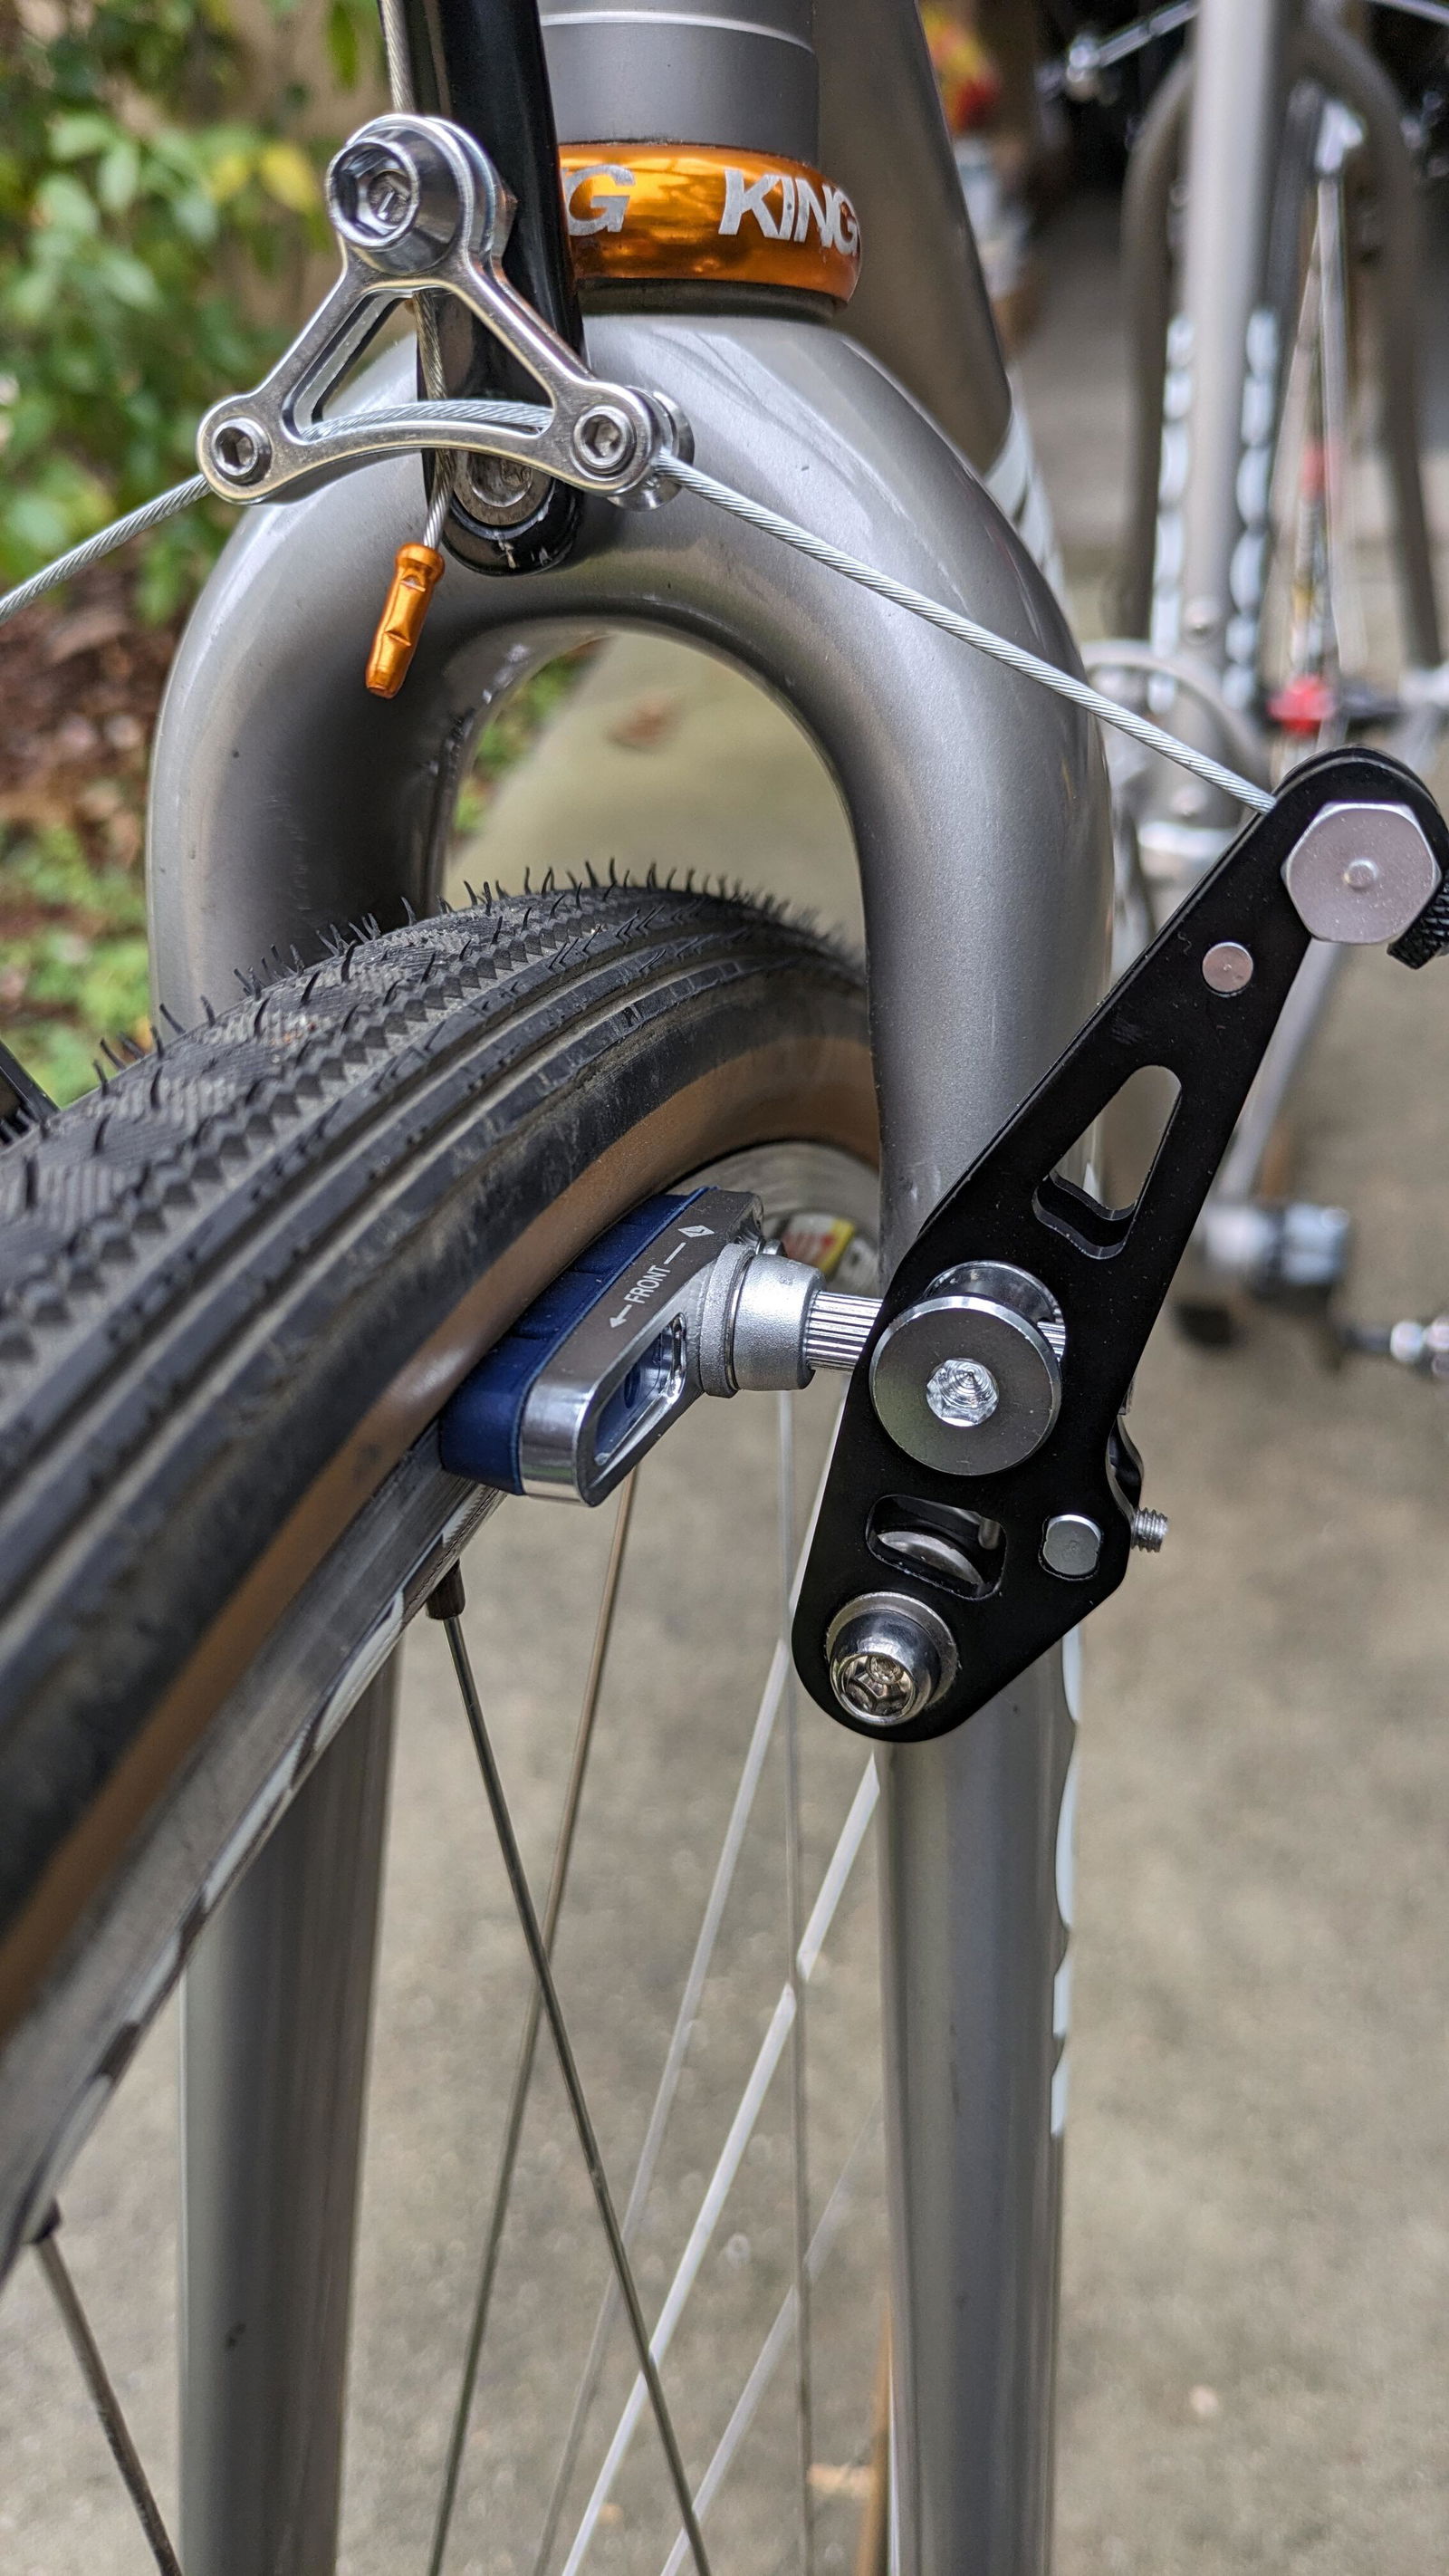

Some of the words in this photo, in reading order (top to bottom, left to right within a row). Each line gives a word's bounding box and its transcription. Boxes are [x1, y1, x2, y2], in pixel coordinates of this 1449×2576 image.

[561, 164, 636, 235] G
[718, 168, 859, 256] KING
[624, 1264, 671, 1304] FRONT
